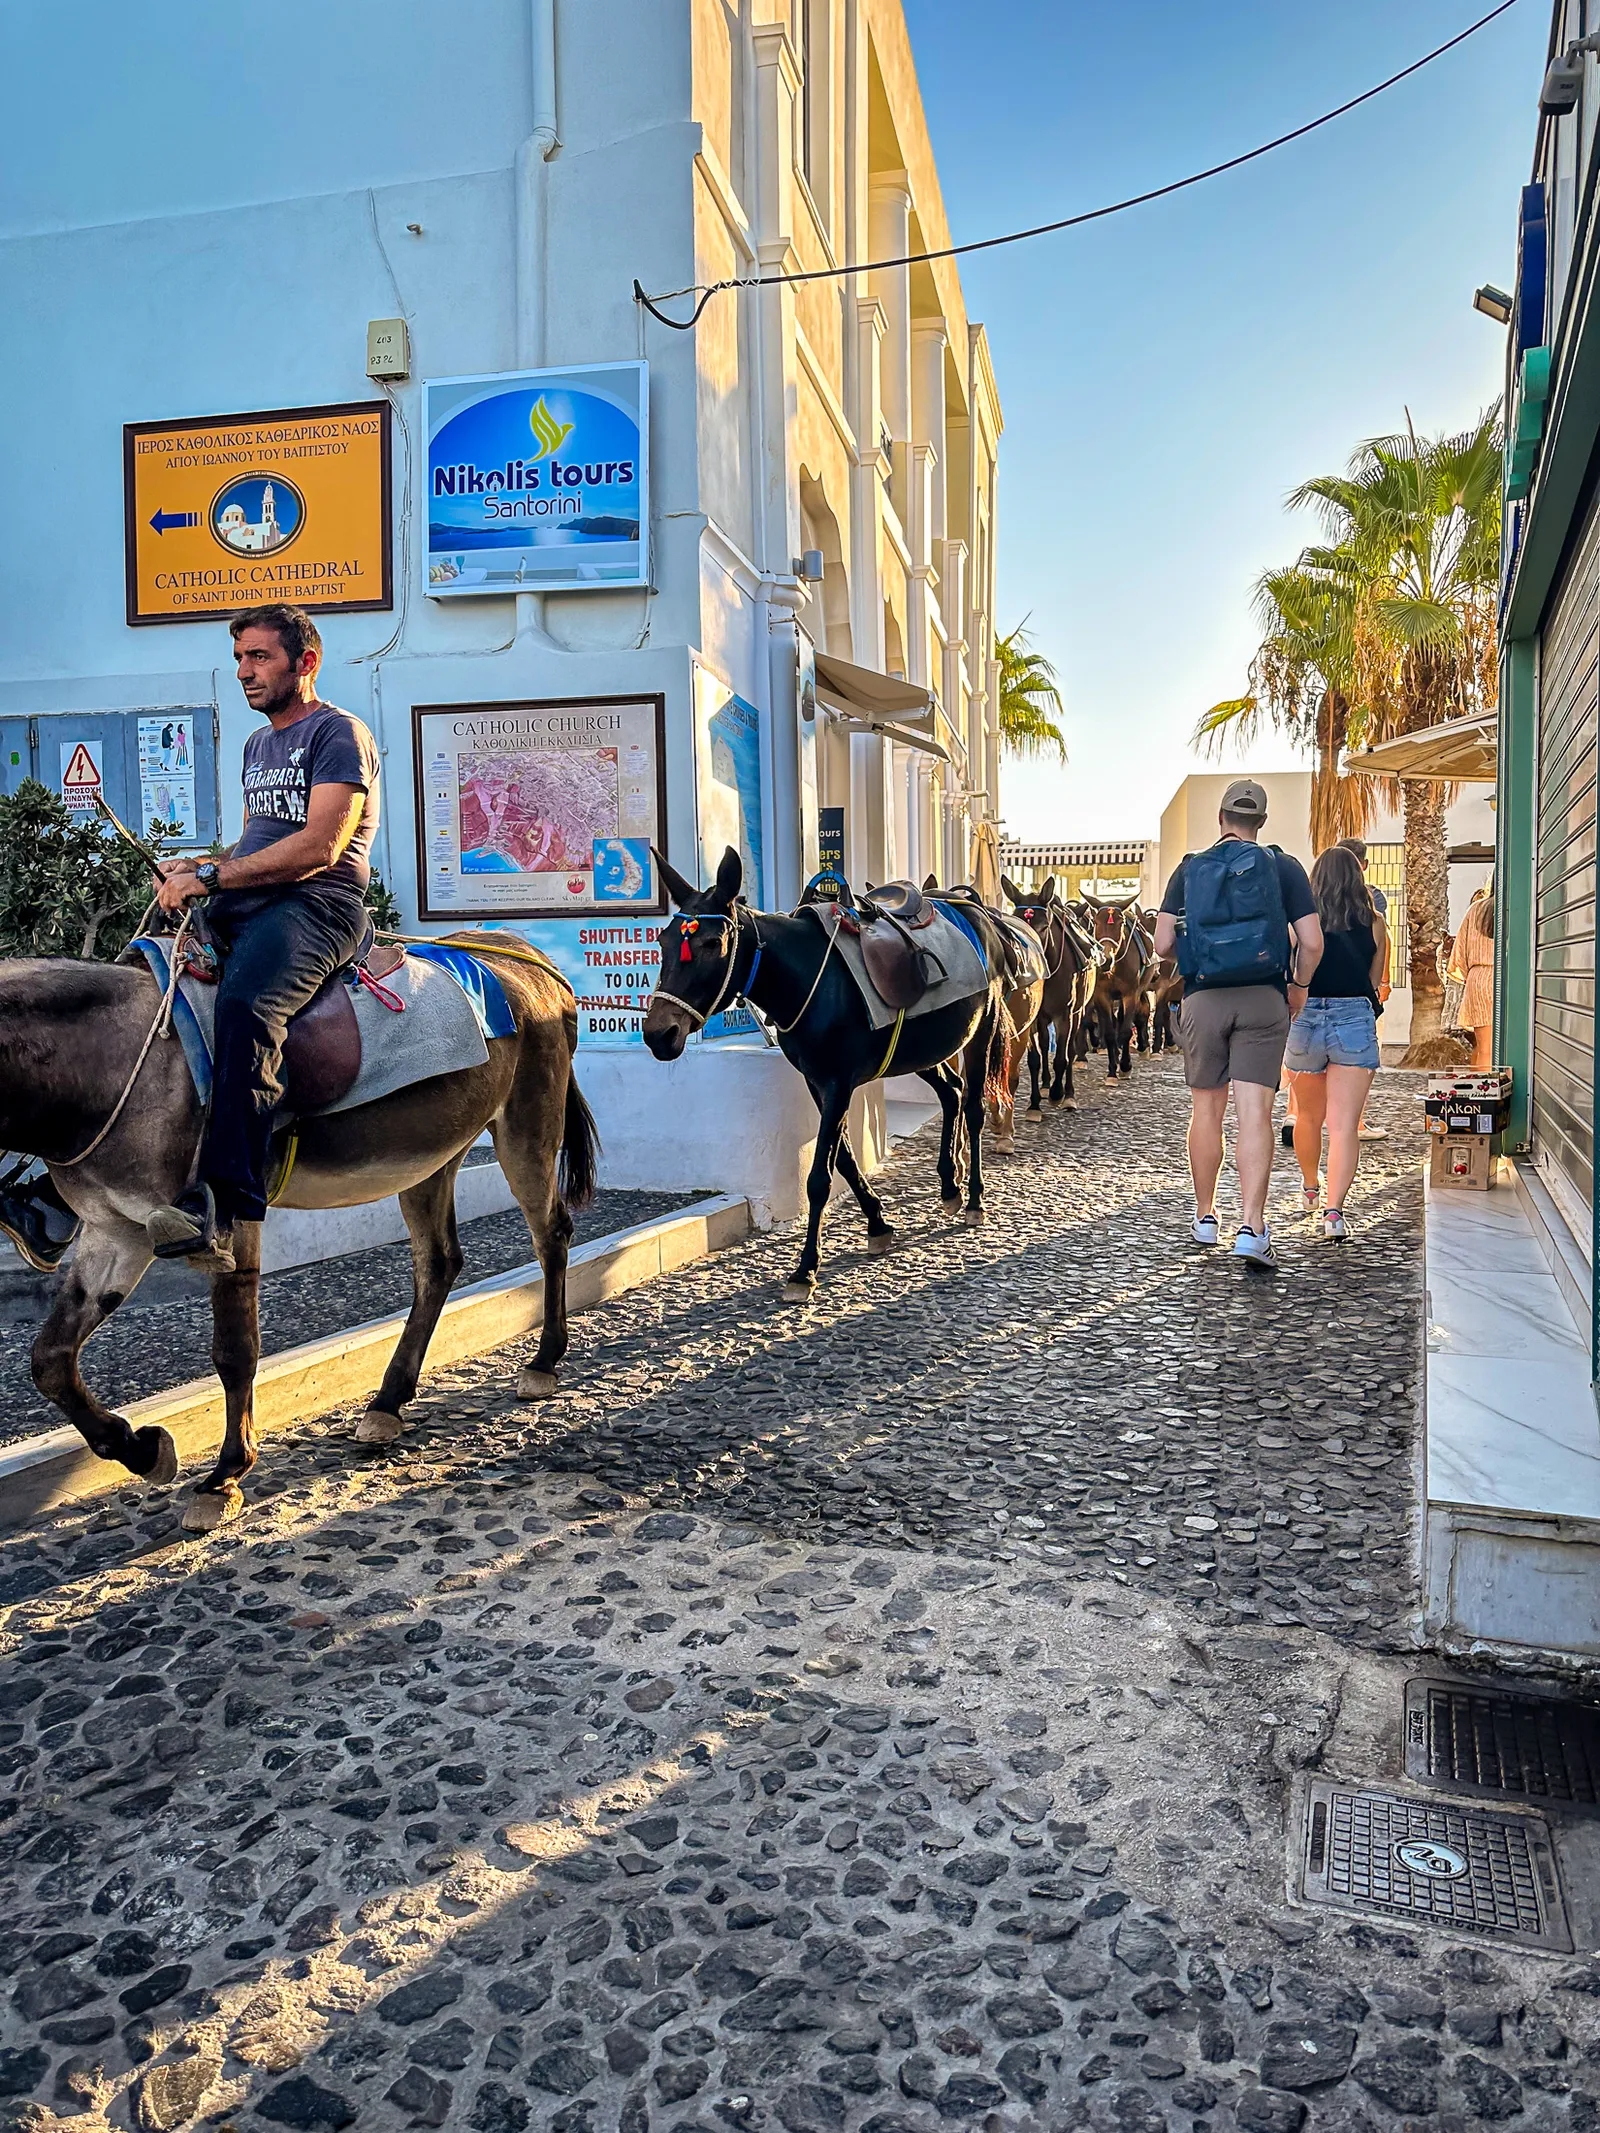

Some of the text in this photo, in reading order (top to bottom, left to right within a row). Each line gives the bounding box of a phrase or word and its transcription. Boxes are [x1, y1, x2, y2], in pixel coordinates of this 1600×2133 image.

[137, 420, 379, 454] ΙΕΡΟΣ ΚΑΘΟΛΙΚΟΣ ΚΑΘΕΔΡΙΚΟΣ ΝΑΟΣ
[165, 442, 350, 469] ΑΓΙΟΥ ΙΩΑΝΝΟΥ ΤΟΥ ΒΑΠΤΙΣΤΟΥ
[434, 460, 634, 496] Nikolis tours
[484, 491, 581, 519] Santorini
[155, 560, 365, 590] CATHOLIC CATHEDRAL
[172, 582, 346, 605] OF SAINT JOHN THE BAPTIST
[453, 715, 621, 736] CATHOLIC CHURCH
[472, 735, 603, 750] ΚΑΘΟΛΙΚΗ ΕΚΚΛΗΣΙΑ
[64, 787, 102, 795] ΠΡΟΣΟΧΗ
[820, 850, 841, 860] ers
[579, 927, 642, 944] SHUTTLE
[584, 950, 663, 966] TRANSFER
[605, 972, 650, 988] TO OIA
[589, 1017, 627, 1033] BOOK
[723, 1010, 737, 1028] BOOK
